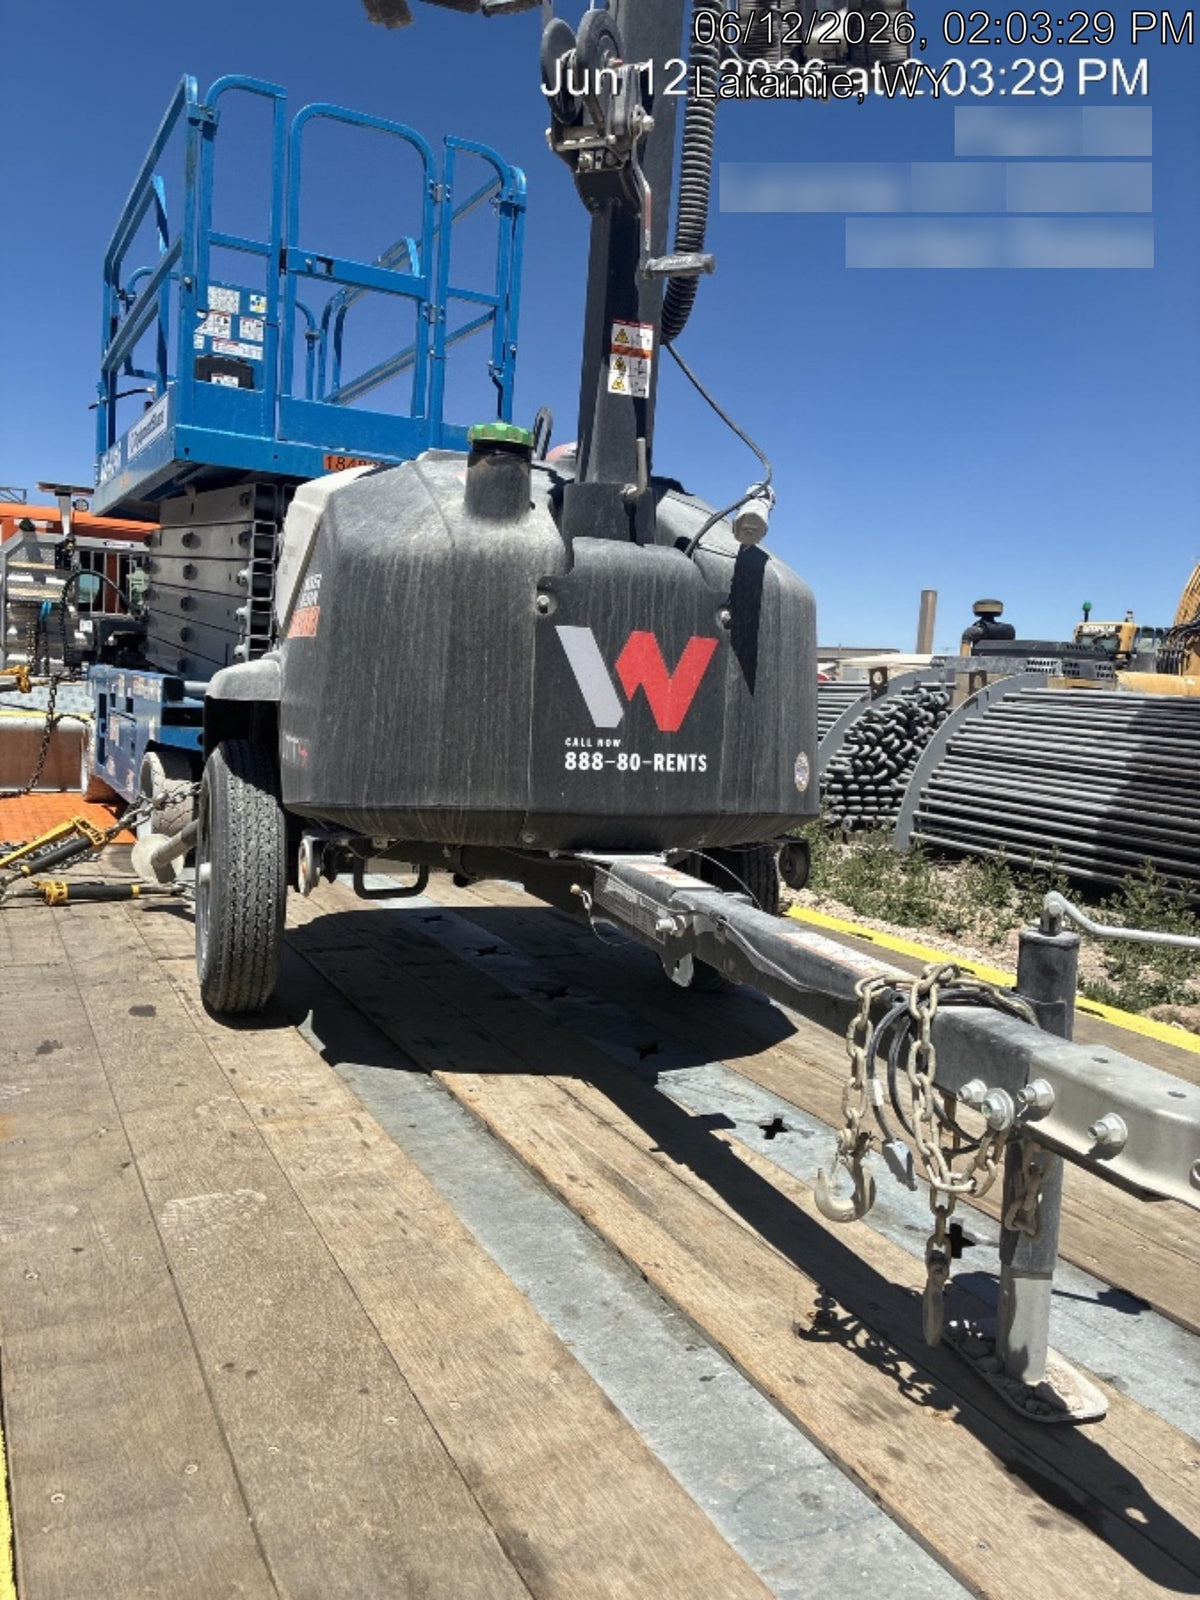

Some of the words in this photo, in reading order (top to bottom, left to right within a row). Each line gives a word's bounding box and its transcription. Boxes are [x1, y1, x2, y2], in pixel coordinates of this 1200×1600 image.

[565, 737, 592, 747] CALL
[597, 738, 621, 748] NOW
[564, 751, 708, 773] 888-80-RENTS
